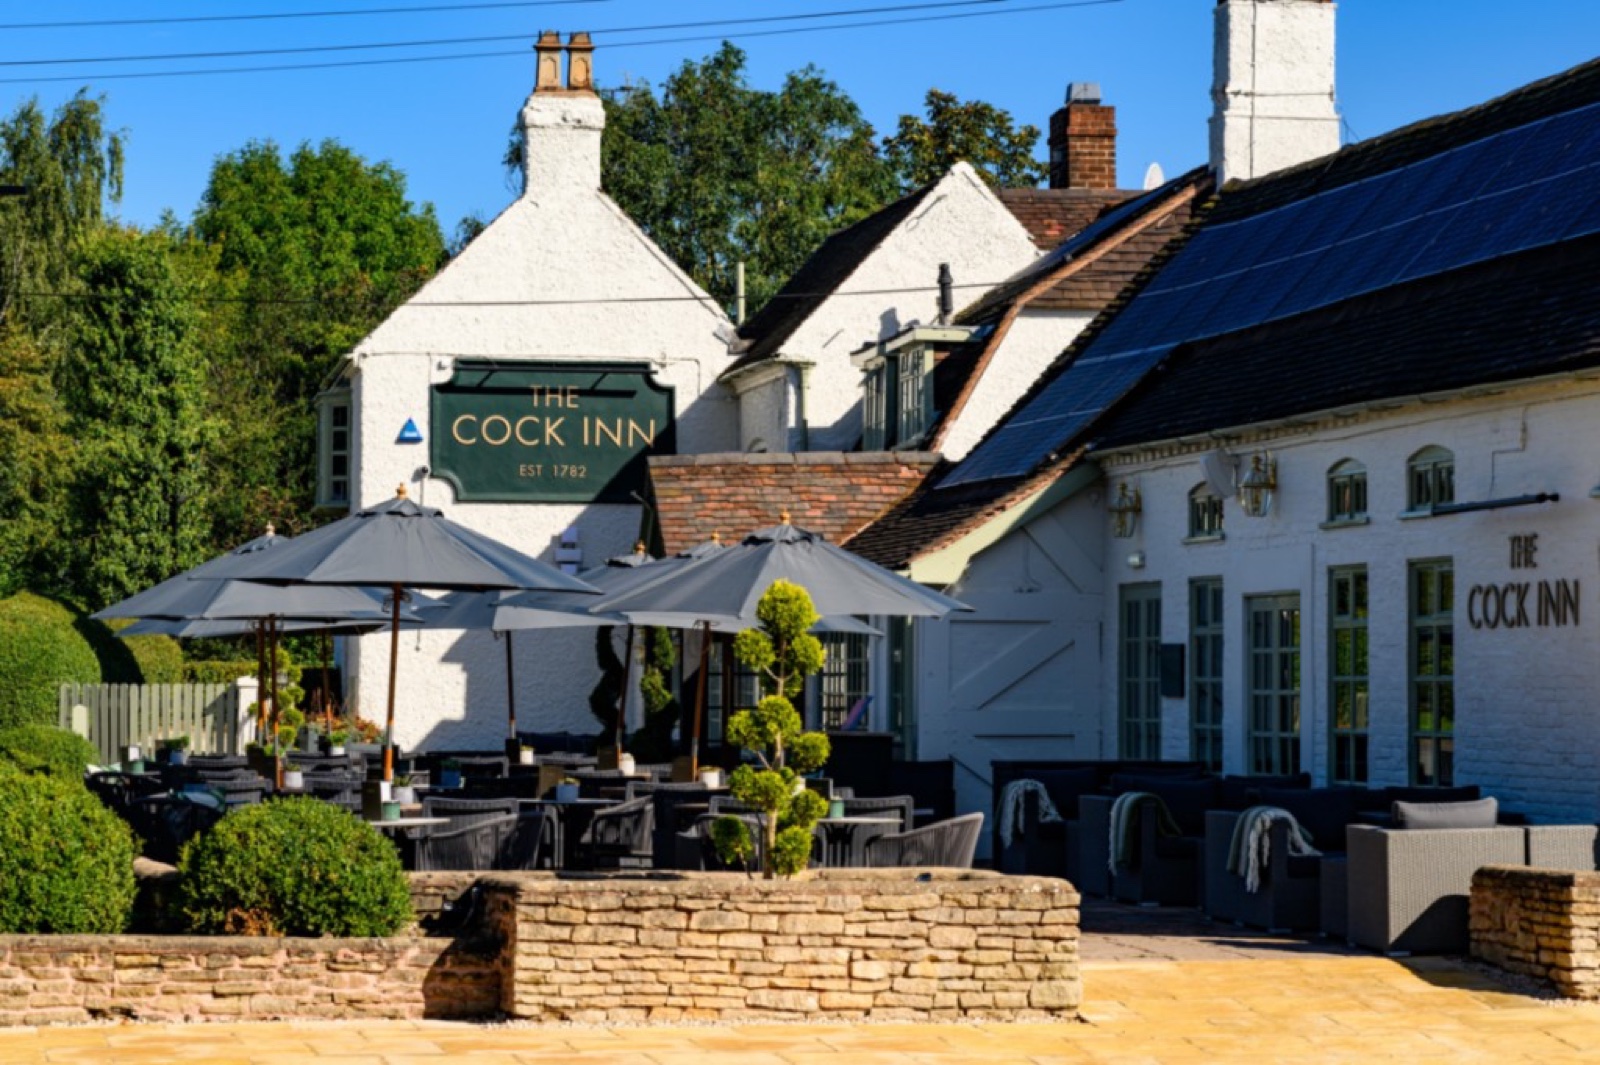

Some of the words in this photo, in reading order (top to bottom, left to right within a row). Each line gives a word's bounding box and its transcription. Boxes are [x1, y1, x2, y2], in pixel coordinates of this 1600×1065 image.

[530, 384, 579, 409] THE
[452, 414, 566, 446] COCK
[583, 415, 656, 448] INN
[519, 464, 543, 477] EST
[553, 465, 587, 478] 1782
[1508, 532, 1539, 570] THE
[1467, 582, 1531, 630] COCK
[1537, 578, 1580, 628] INN
